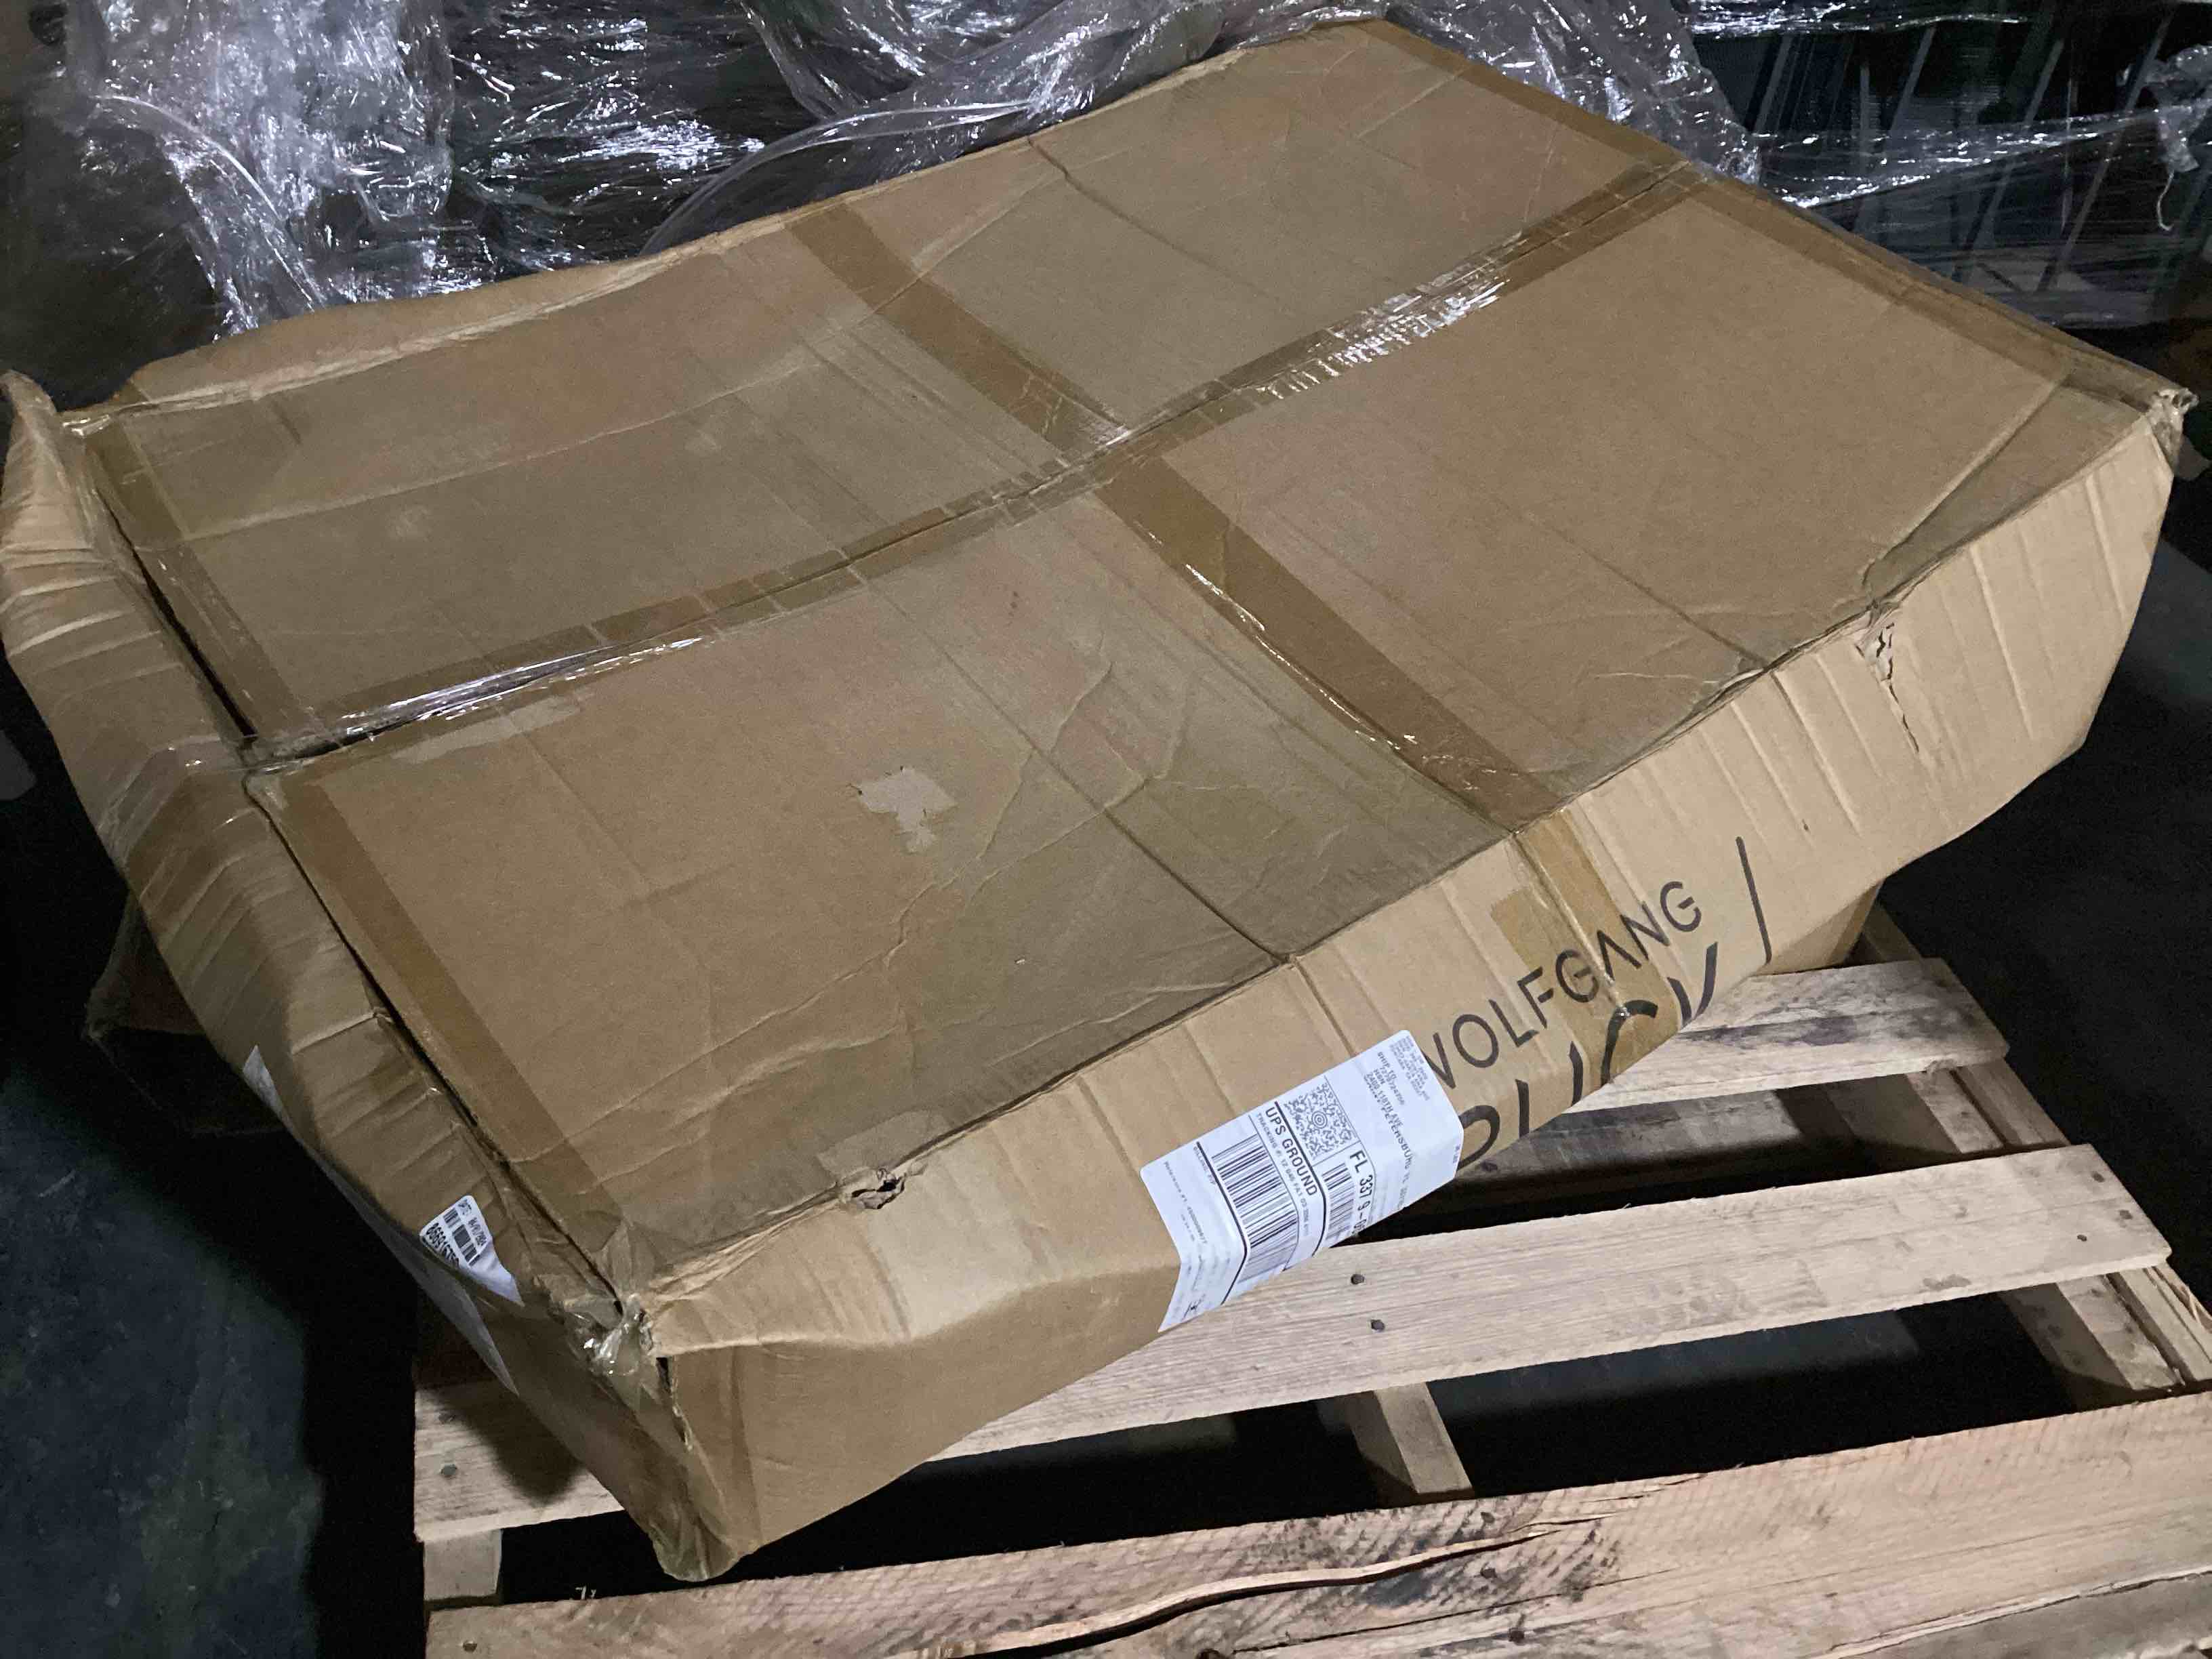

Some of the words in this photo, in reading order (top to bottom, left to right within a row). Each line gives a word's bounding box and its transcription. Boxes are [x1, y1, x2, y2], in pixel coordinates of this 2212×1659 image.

[1256, 1113, 1278, 1149] TRACKING
[1264, 1106, 1288, 1135] UPS
[1280, 1137, 1318, 1197] GROUND
[1349, 1150, 1370, 1172] FL
[1359, 1174, 1374, 1197] 337
